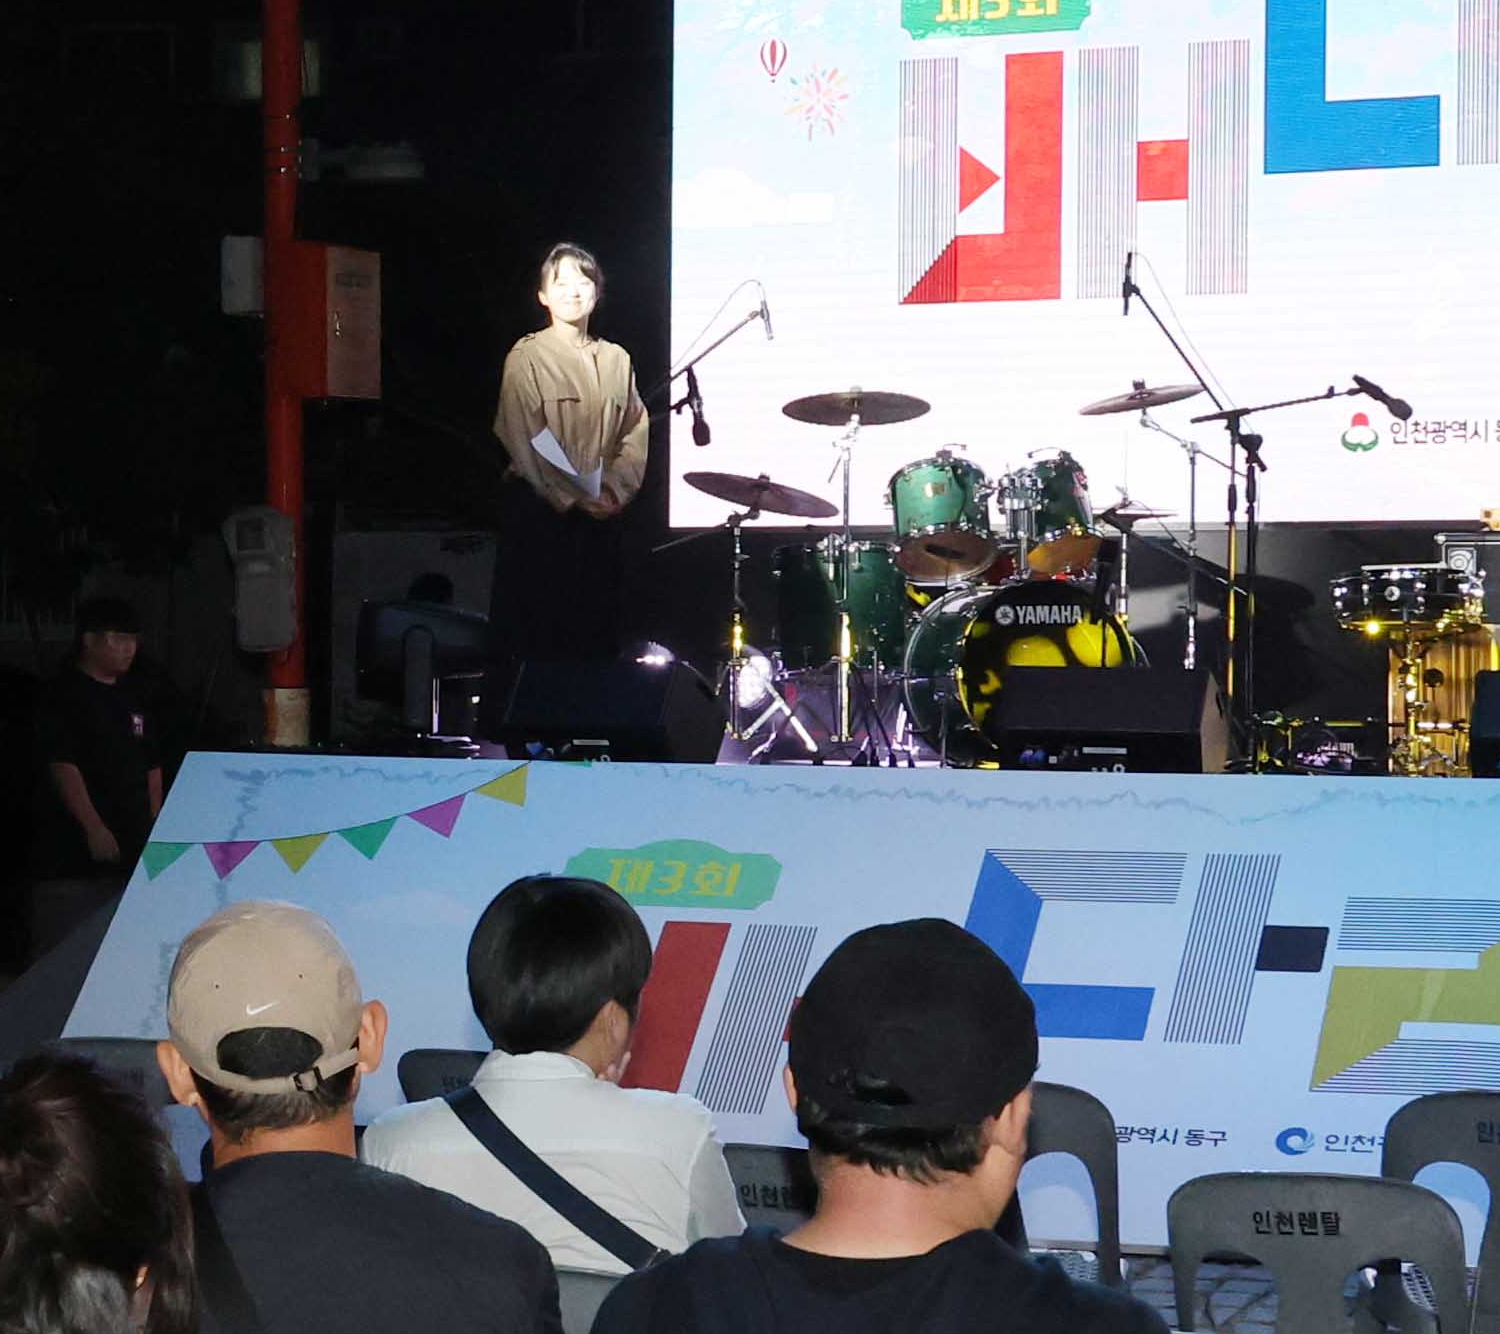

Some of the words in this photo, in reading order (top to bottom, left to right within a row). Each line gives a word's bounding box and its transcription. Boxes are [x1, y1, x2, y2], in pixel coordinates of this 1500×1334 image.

[1389, 419, 1489, 445] 인천광역시
[1016, 604, 1083, 626] YAMAHA
[607, 857, 743, 899] 제3회
[1184, 1128, 1228, 1147] 동구
[1325, 1133, 1386, 1154] 인천
[1252, 1210, 1341, 1236] 인천렌탈
